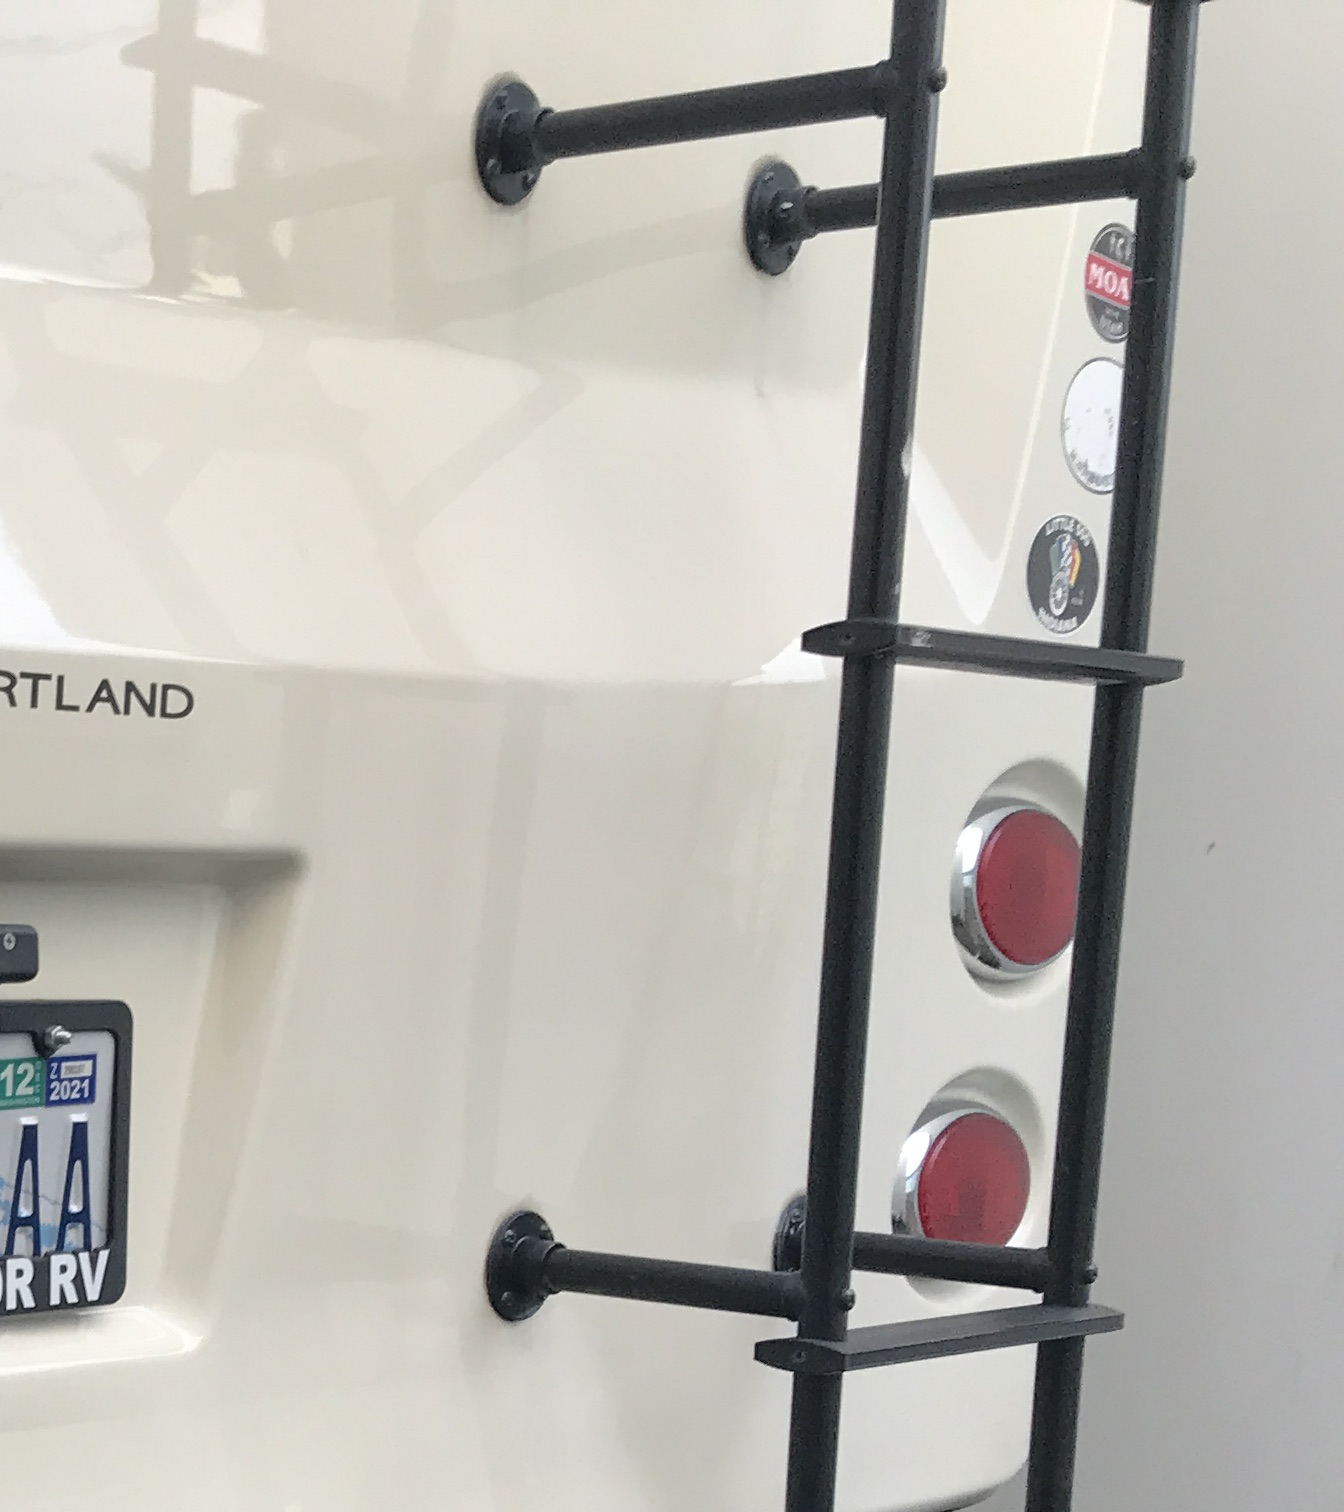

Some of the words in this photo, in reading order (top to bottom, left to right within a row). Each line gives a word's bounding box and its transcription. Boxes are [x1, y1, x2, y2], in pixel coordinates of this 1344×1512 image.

[1088, 262, 1131, 301] MOA
[0, 1062, 34, 1097] 12
[49, 1079, 90, 1102] 2021
[49, 1248, 111, 1308] RV
